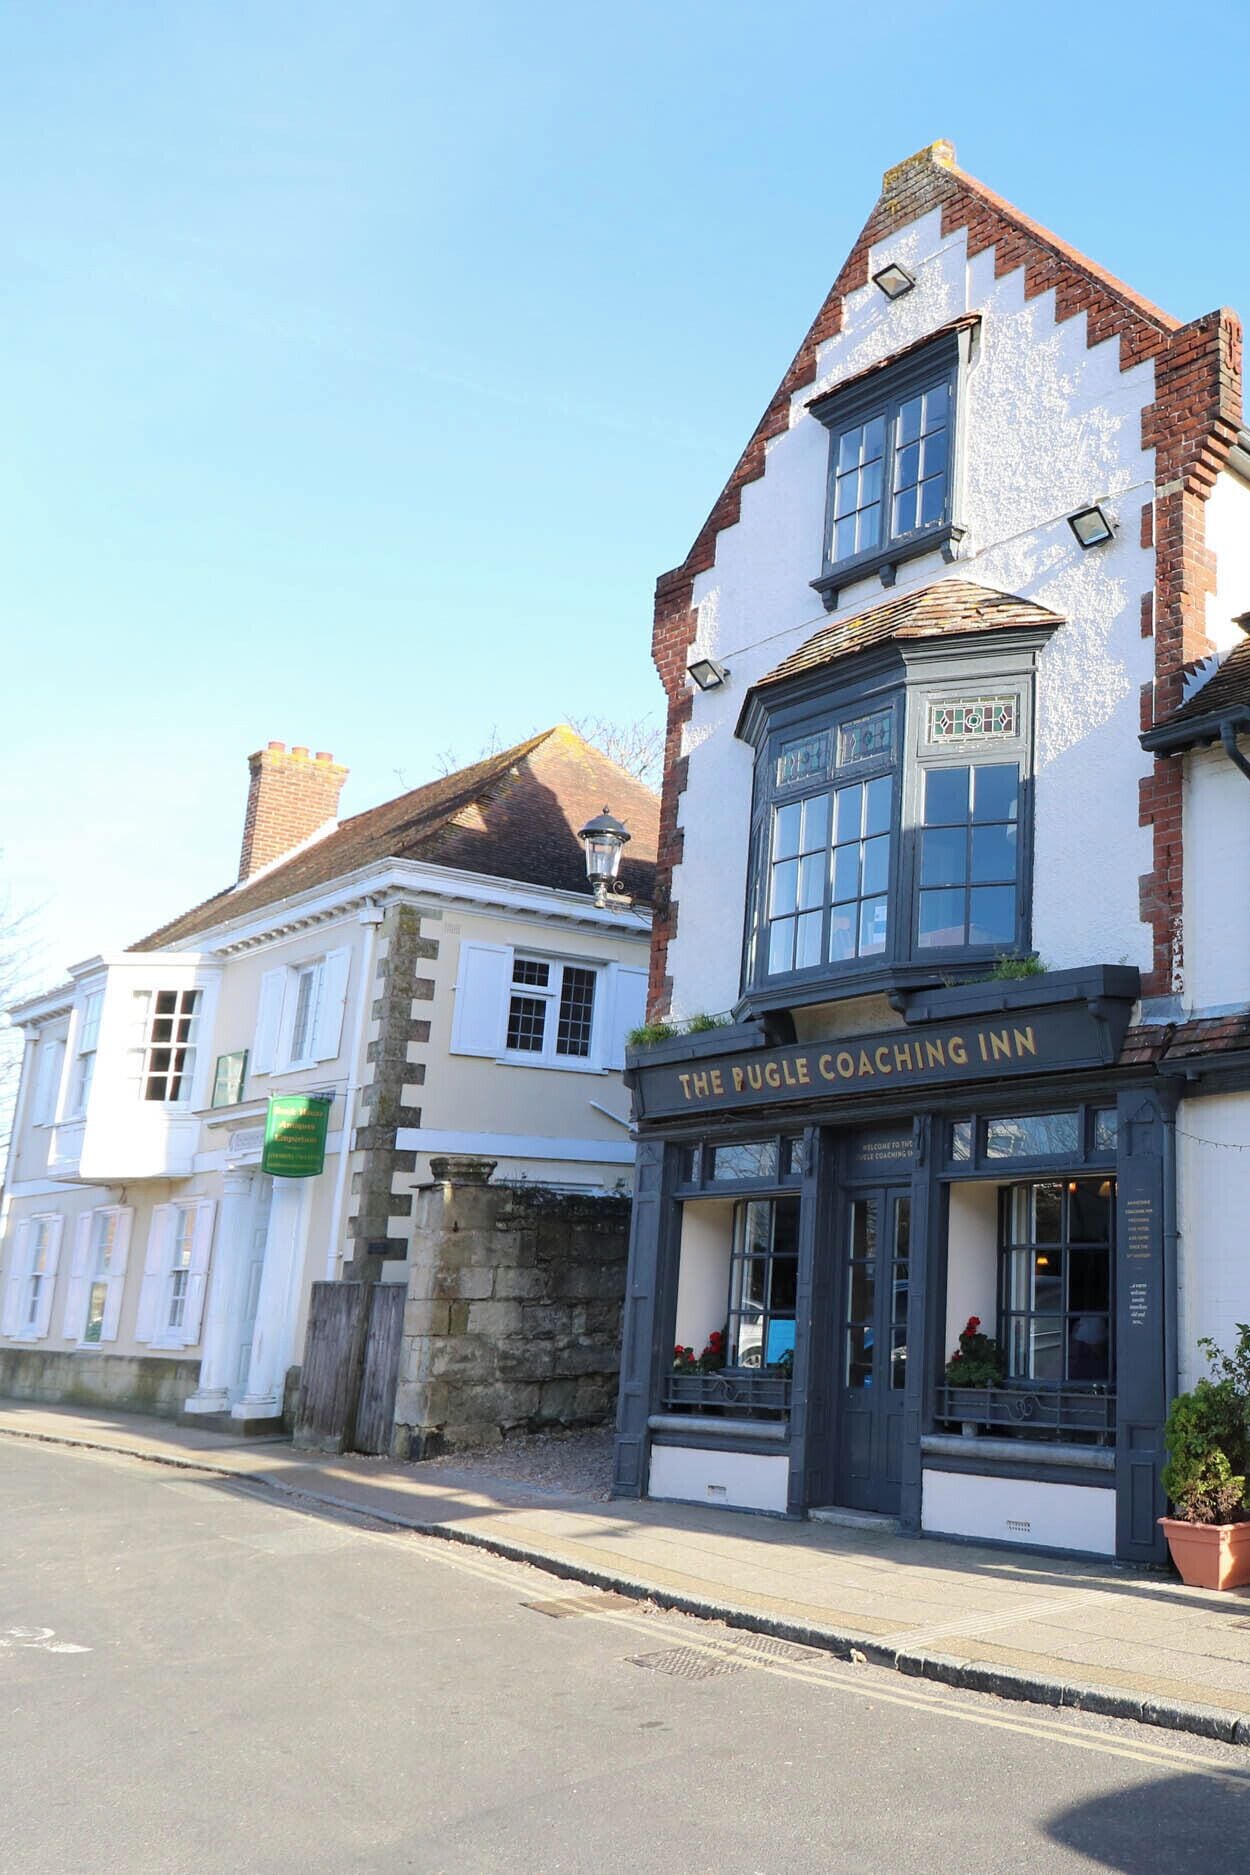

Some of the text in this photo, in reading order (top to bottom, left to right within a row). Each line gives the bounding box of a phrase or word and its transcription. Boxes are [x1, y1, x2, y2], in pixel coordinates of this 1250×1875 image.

[678, 1069, 724, 1100] THE
[818, 1035, 969, 1081] COACHING
[978, 1025, 1038, 1062] INN
